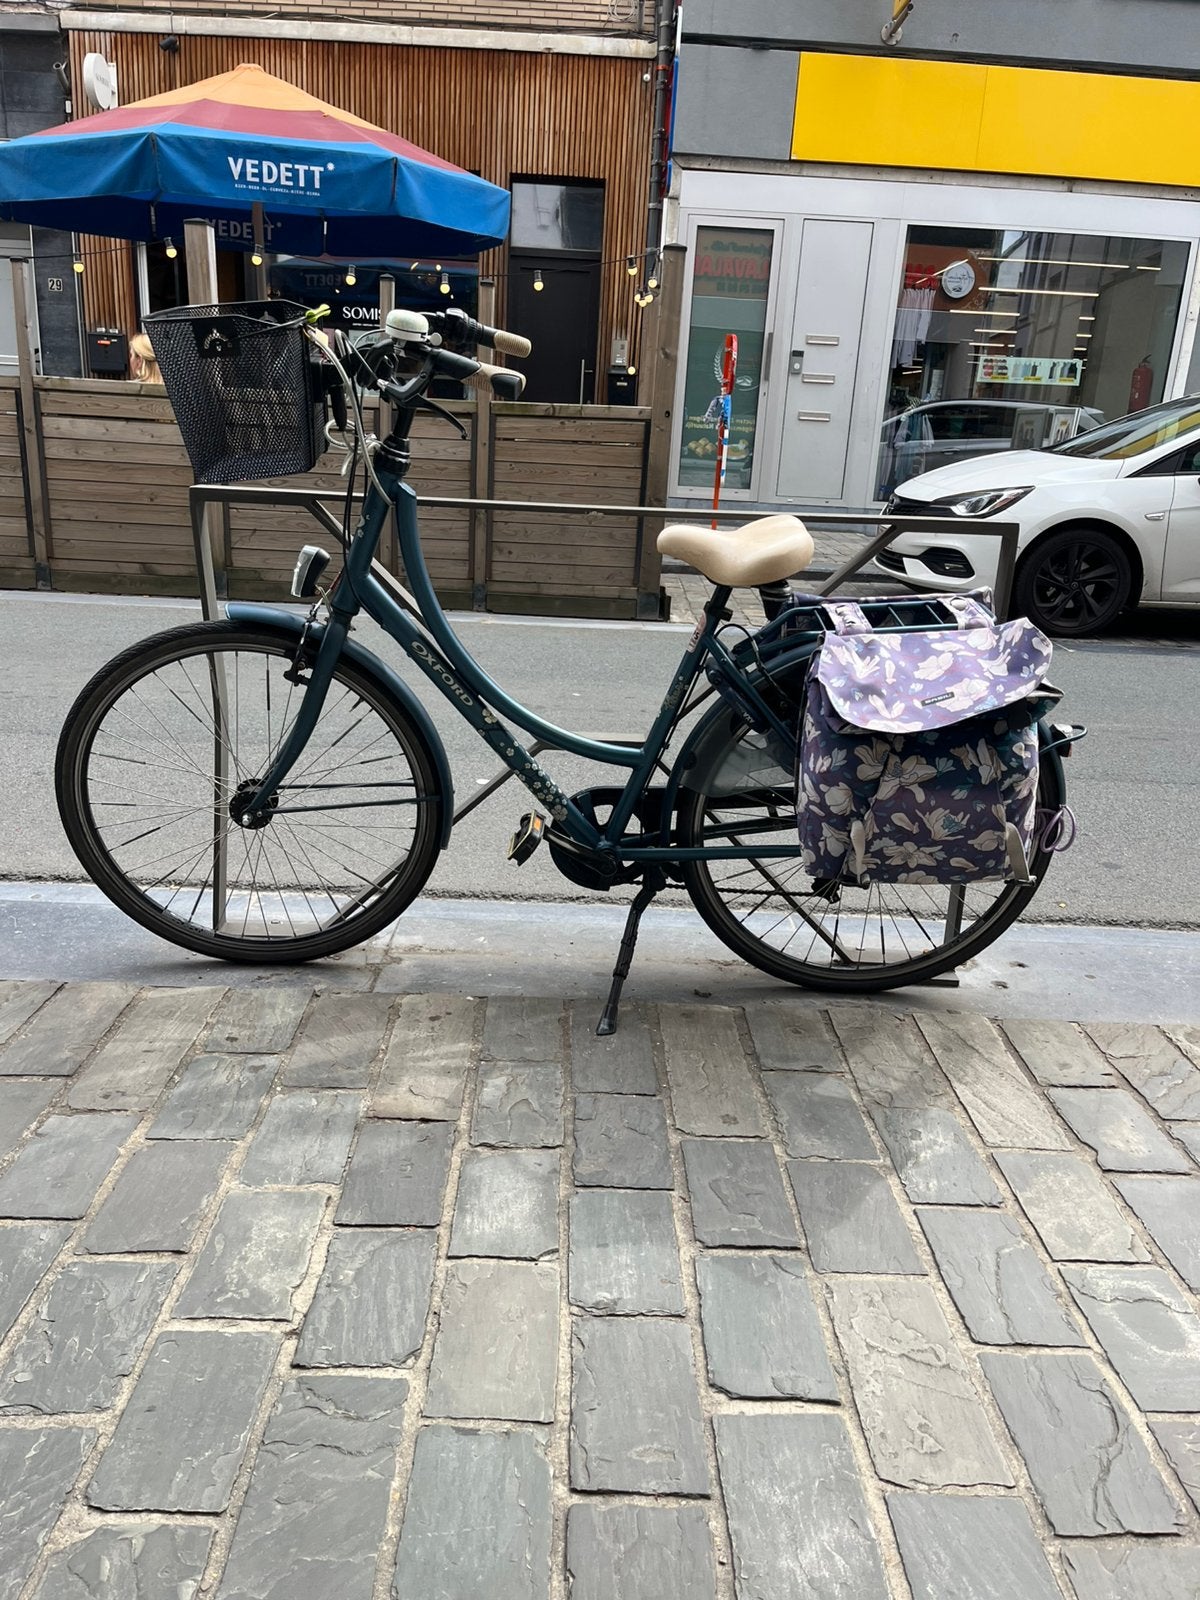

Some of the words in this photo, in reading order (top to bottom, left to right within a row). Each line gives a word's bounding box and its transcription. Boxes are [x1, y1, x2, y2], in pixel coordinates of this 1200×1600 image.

[227, 156, 325, 189] VEDETT
[206, 217, 274, 241] EDET
[49, 279, 62, 291] 29
